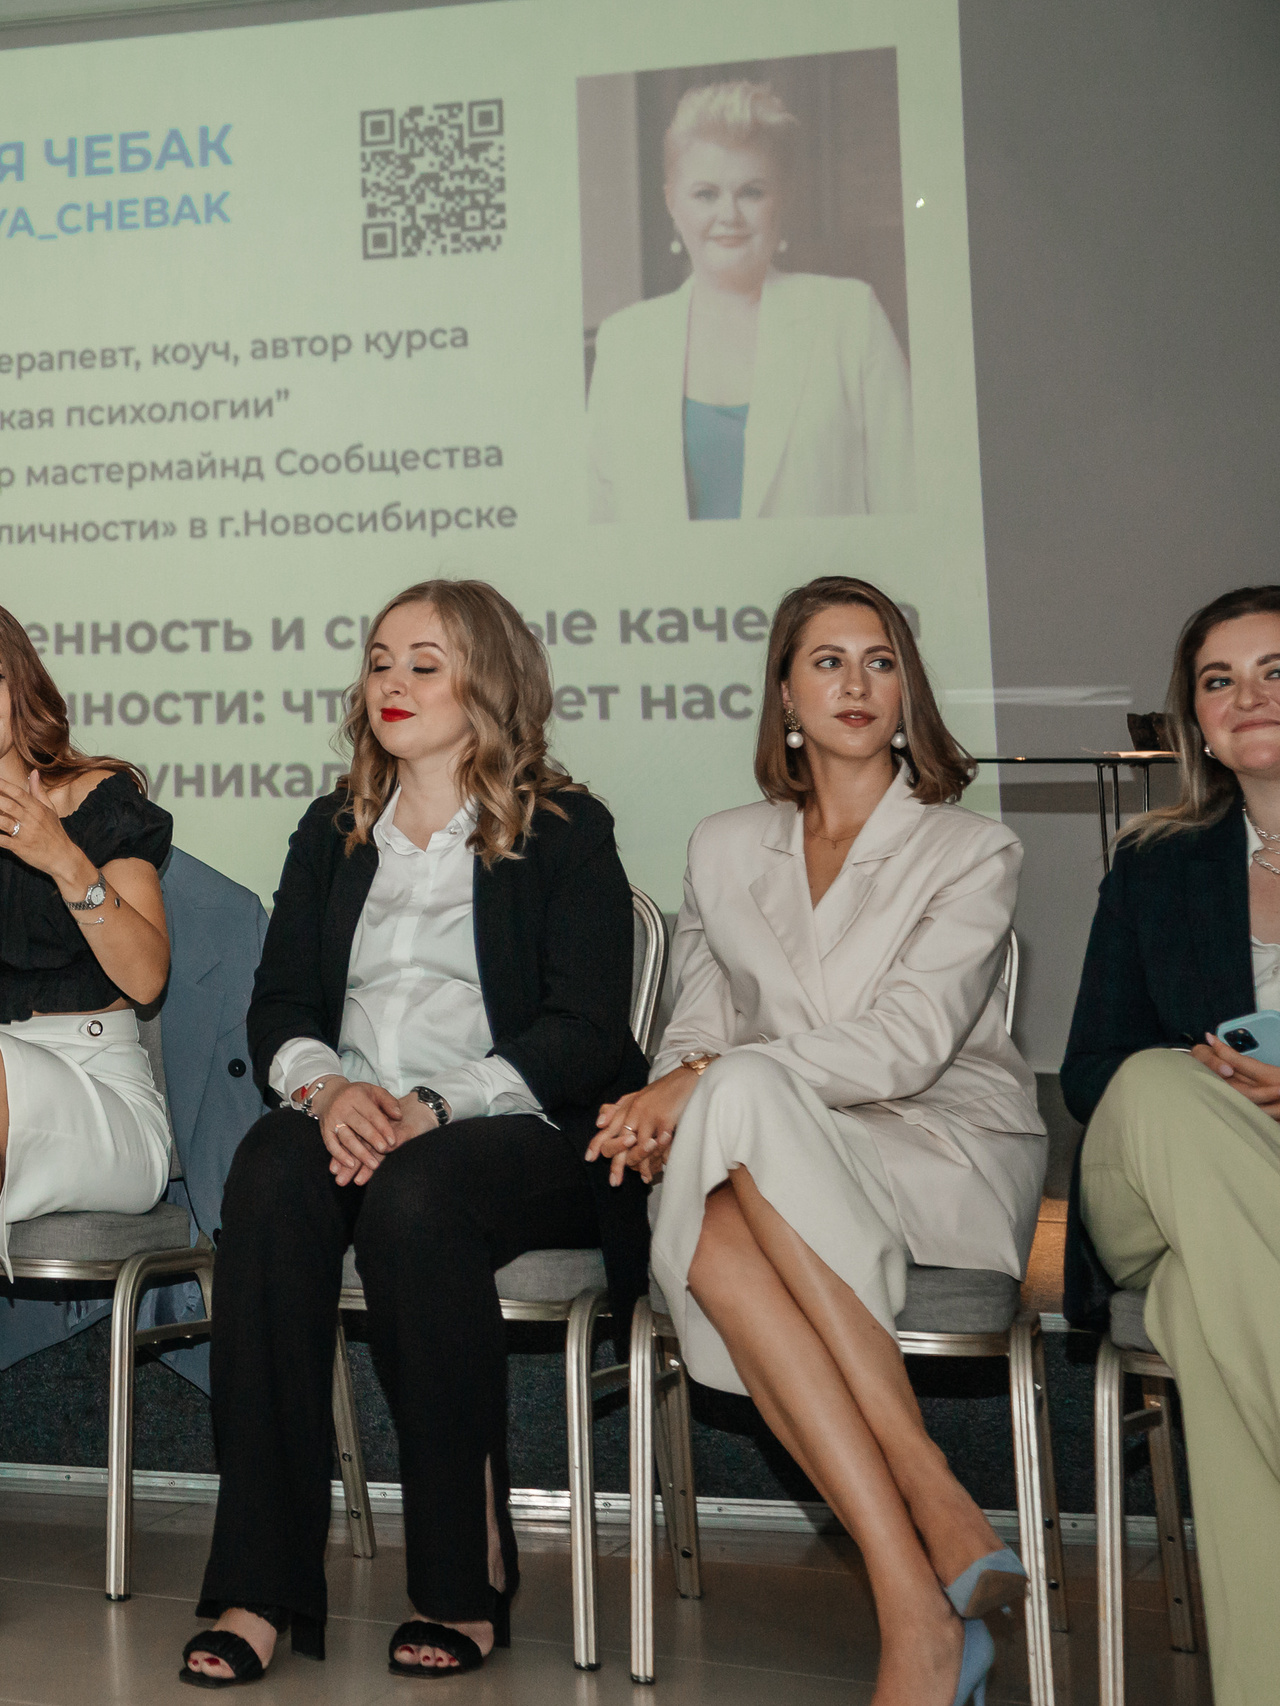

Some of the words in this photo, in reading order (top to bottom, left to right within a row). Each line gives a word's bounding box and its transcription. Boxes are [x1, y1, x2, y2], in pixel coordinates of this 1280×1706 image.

[43, 123, 234, 179] ЧЕБАК
[151, 340, 240, 372] коуч,
[249, 333, 354, 363] автор
[364, 326, 470, 361] курса
[26, 450, 266, 491] мастермайнд
[274, 441, 505, 478] Сообщества
[188, 516, 209, 540] в
[218, 500, 519, 539] г.Новосибирске
[271, 616, 306, 652] и
[282, 687, 347, 724] чт
[640, 682, 755, 721] нас
